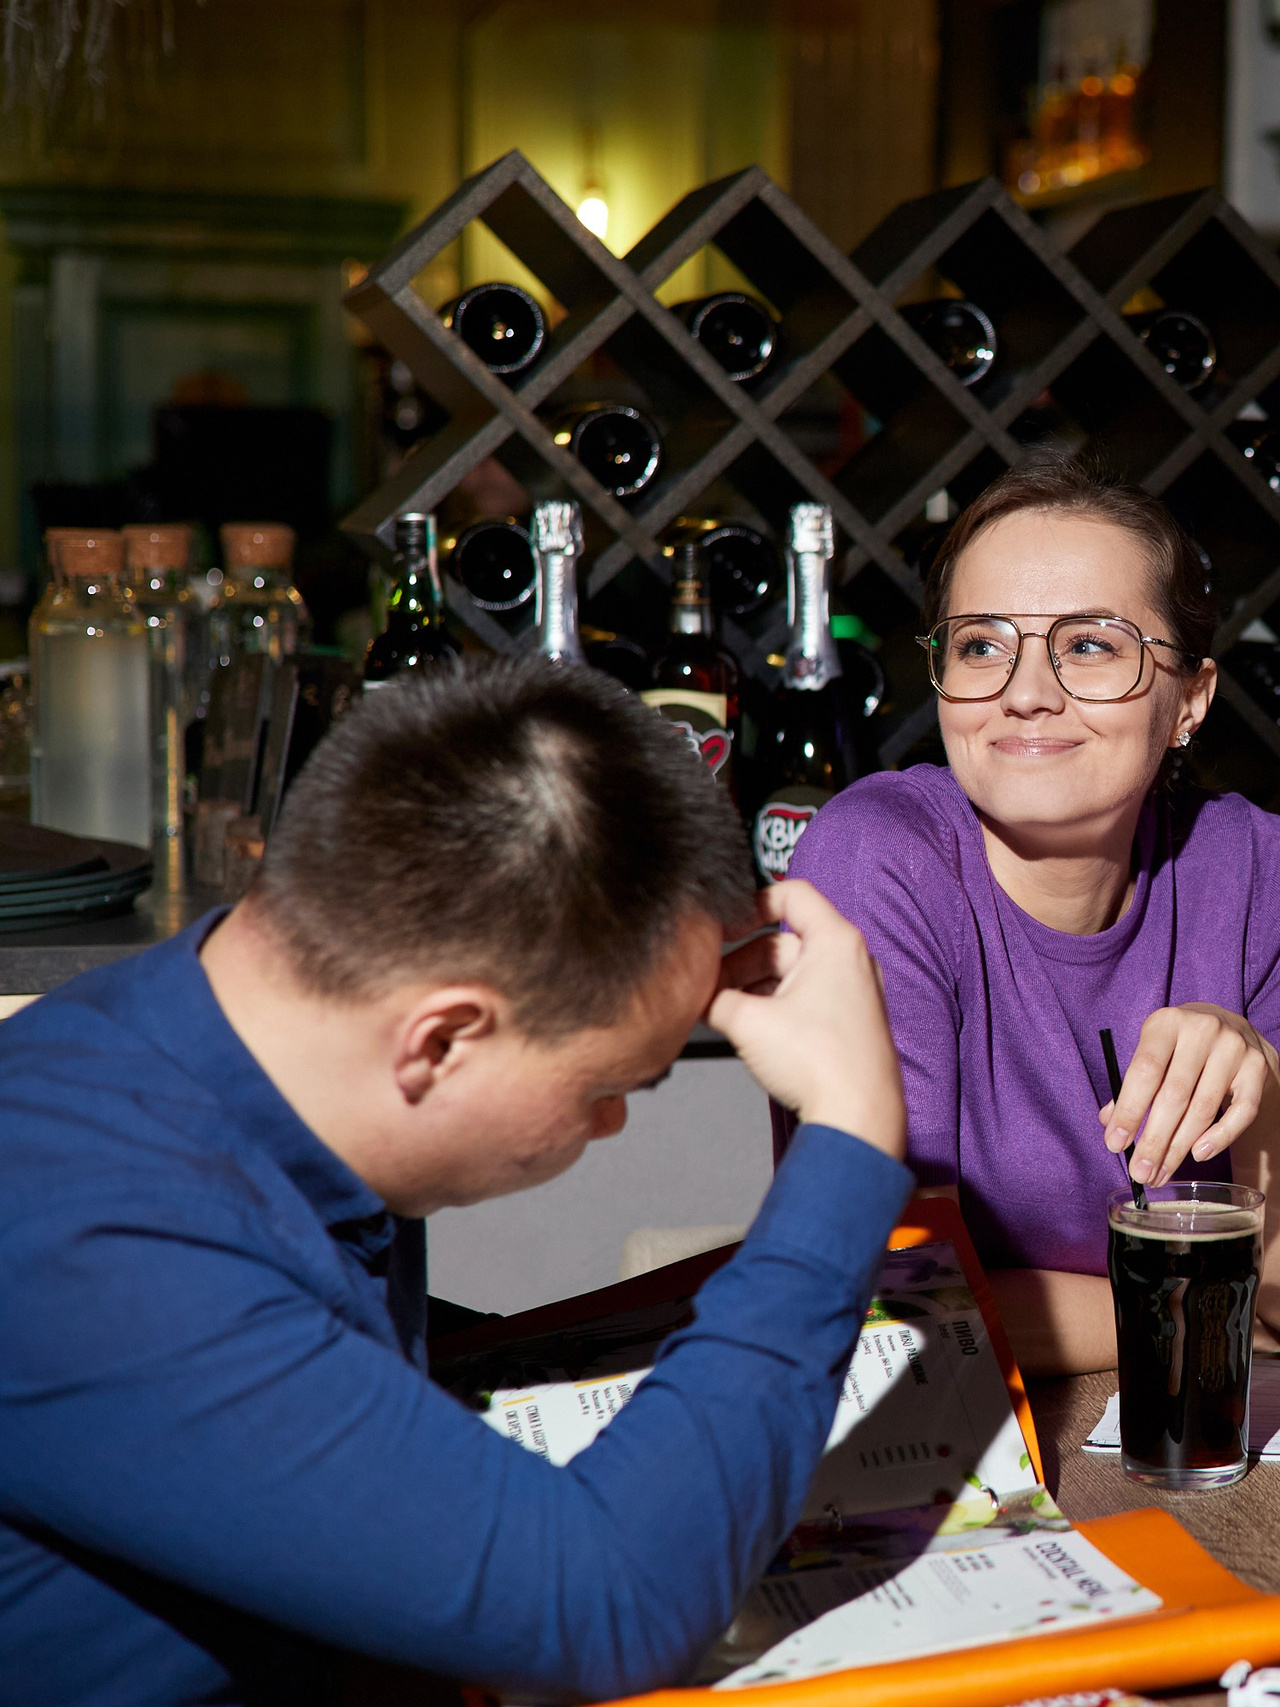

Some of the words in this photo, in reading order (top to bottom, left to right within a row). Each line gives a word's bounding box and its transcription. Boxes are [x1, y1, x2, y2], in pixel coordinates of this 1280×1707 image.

[760, 816, 808, 851] КВИ
[898, 1329, 915, 1347] ПИВО
[938, 1323, 951, 1339] beer
[952, 1320, 979, 1356] ПИВО
[1035, 1541, 1086, 1579] COCKTAIL
